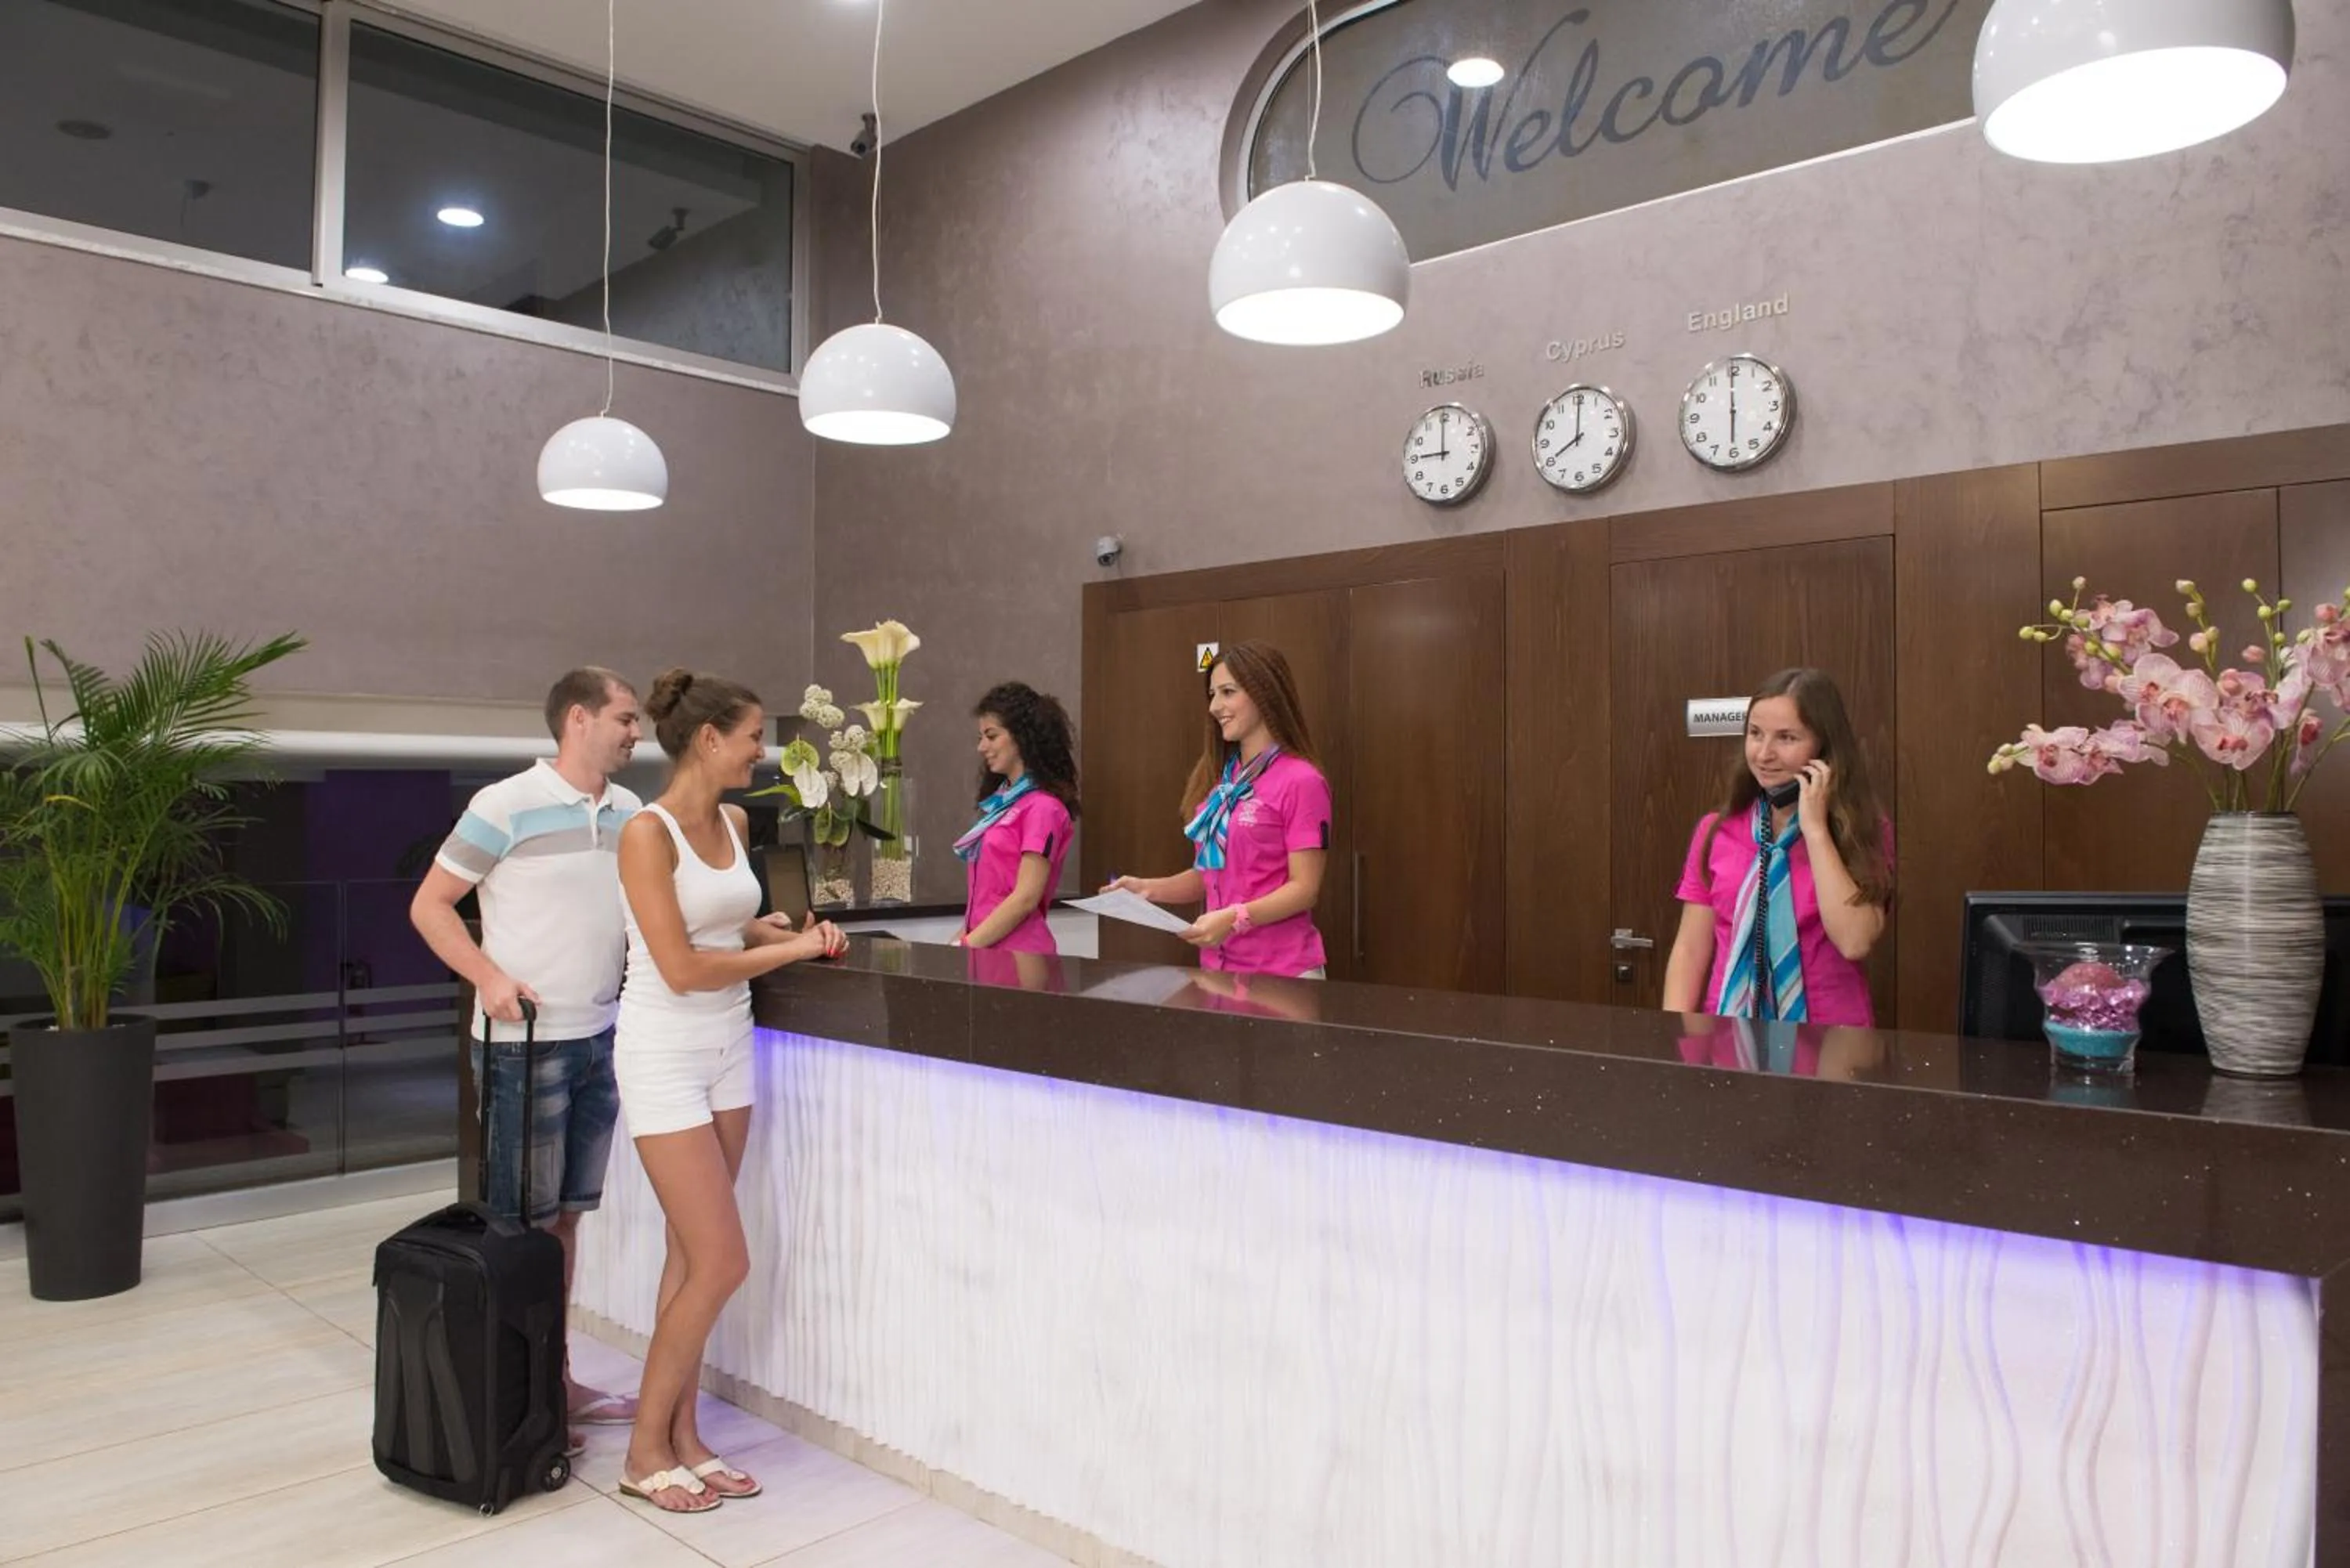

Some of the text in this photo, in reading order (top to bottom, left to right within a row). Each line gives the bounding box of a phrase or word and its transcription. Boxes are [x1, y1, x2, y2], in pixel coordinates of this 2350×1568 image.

[1351, 0, 1958, 193] Welcome
[1688, 291, 1789, 333] England
[1546, 331, 1626, 363] Cyprus
[1419, 360, 1484, 389] Russia
[1762, 381, 1772, 392] 2
[1696, 392, 1706, 403] 10
[1769, 400, 1779, 412] 3
[1690, 413, 1700, 424] 9
[1545, 420, 1555, 430] 10
[1762, 421, 1772, 432] 4
[1609, 427, 1619, 438] 3
[1696, 432, 1707, 443] 8
[1539, 439, 1549, 449] 9
[1748, 438, 1759, 450] 5
[1604, 446, 1614, 457] 4
[1710, 444, 1719, 456] 7
[1729, 447, 1739, 458] 6
[1546, 457, 1556, 467] 8
[1558, 468, 1567, 479] 7
[1592, 463, 1602, 474] 5
[1574, 471, 1584, 482] 6
